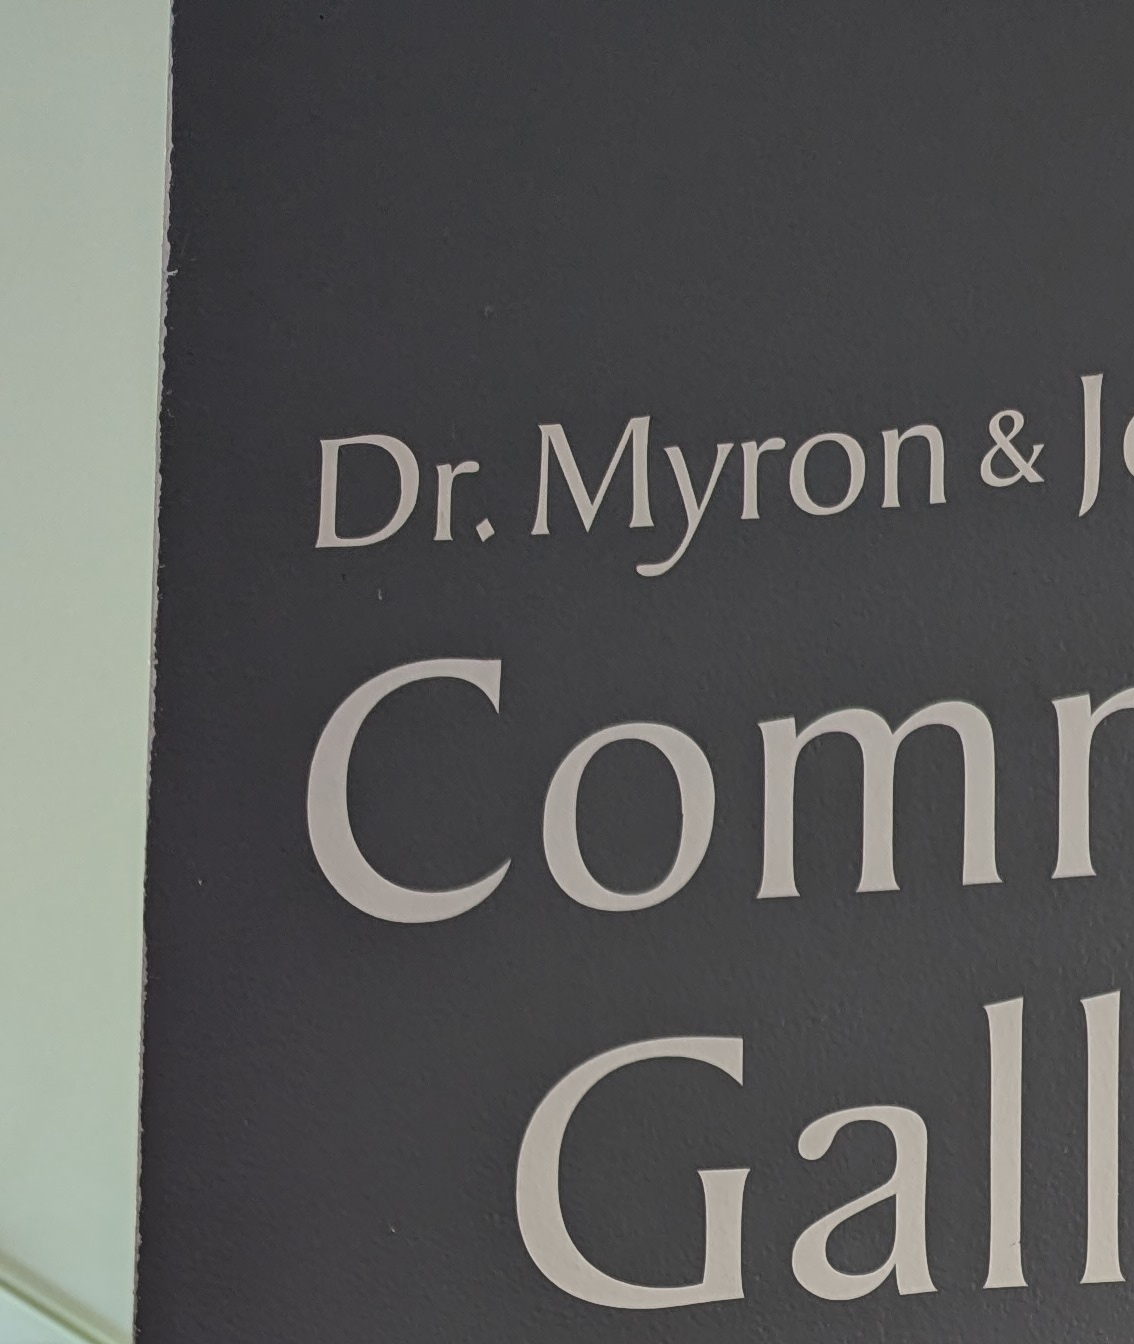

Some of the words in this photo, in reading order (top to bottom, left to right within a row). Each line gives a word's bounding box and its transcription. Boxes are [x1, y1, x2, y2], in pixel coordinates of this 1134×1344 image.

[314, 434, 495, 549] Dr.
[530, 415, 947, 577] Myron
[980, 409, 1045, 488] &
